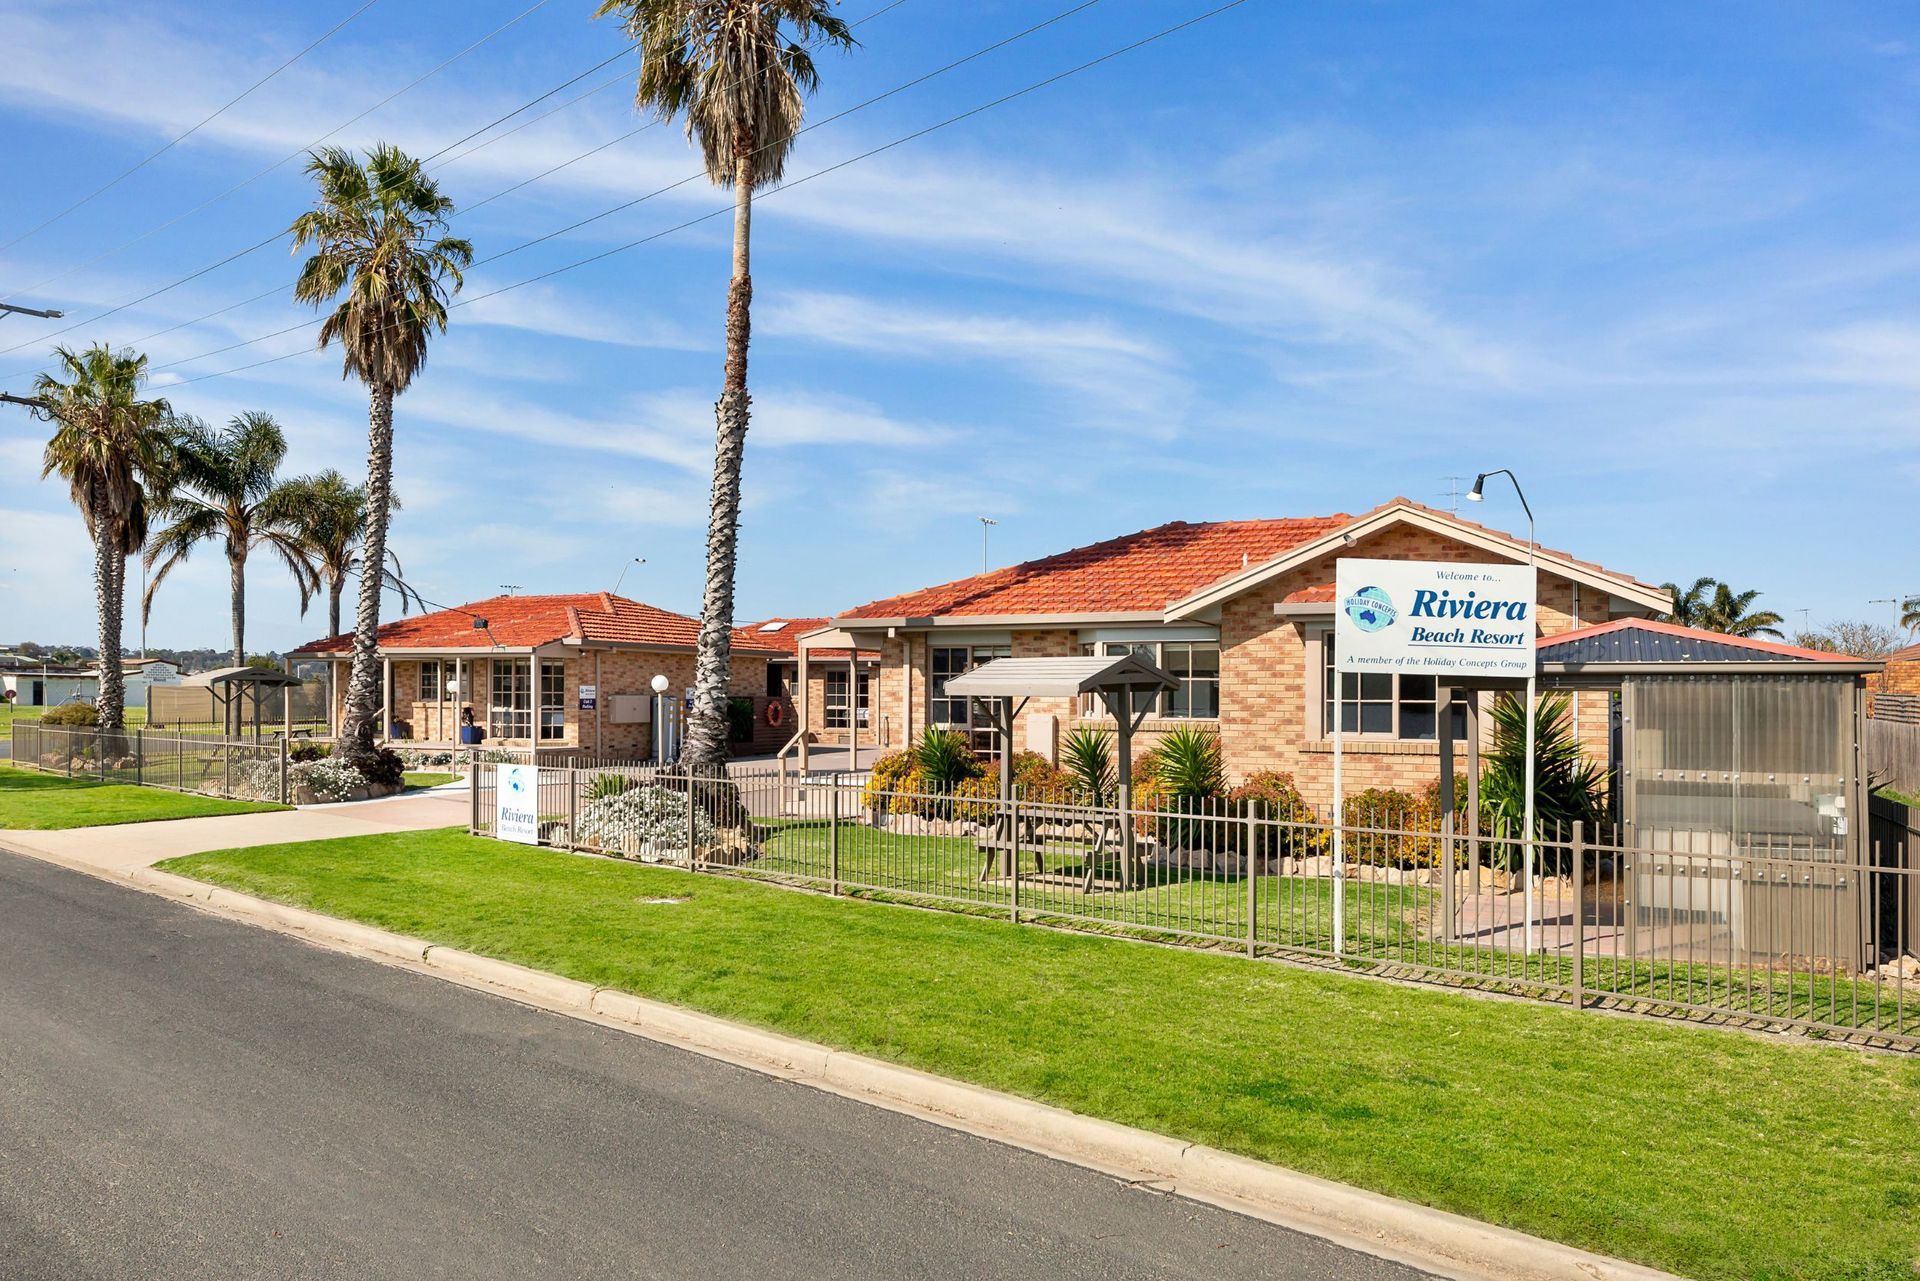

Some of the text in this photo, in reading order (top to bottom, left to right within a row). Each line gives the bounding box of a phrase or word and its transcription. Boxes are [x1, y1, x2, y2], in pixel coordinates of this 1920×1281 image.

[1436, 570, 1503, 582] Welcome to...
[1346, 598, 1398, 618] HOLIDAY CONCEPTS
[1408, 589, 1527, 621] Riviera
[1411, 626, 1525, 645] Beach Resort
[1347, 655, 1527, 670] A member of the Holiday Concepts Group
[501, 807, 534, 824] Riviera
[518, 826, 533, 835] Resort
